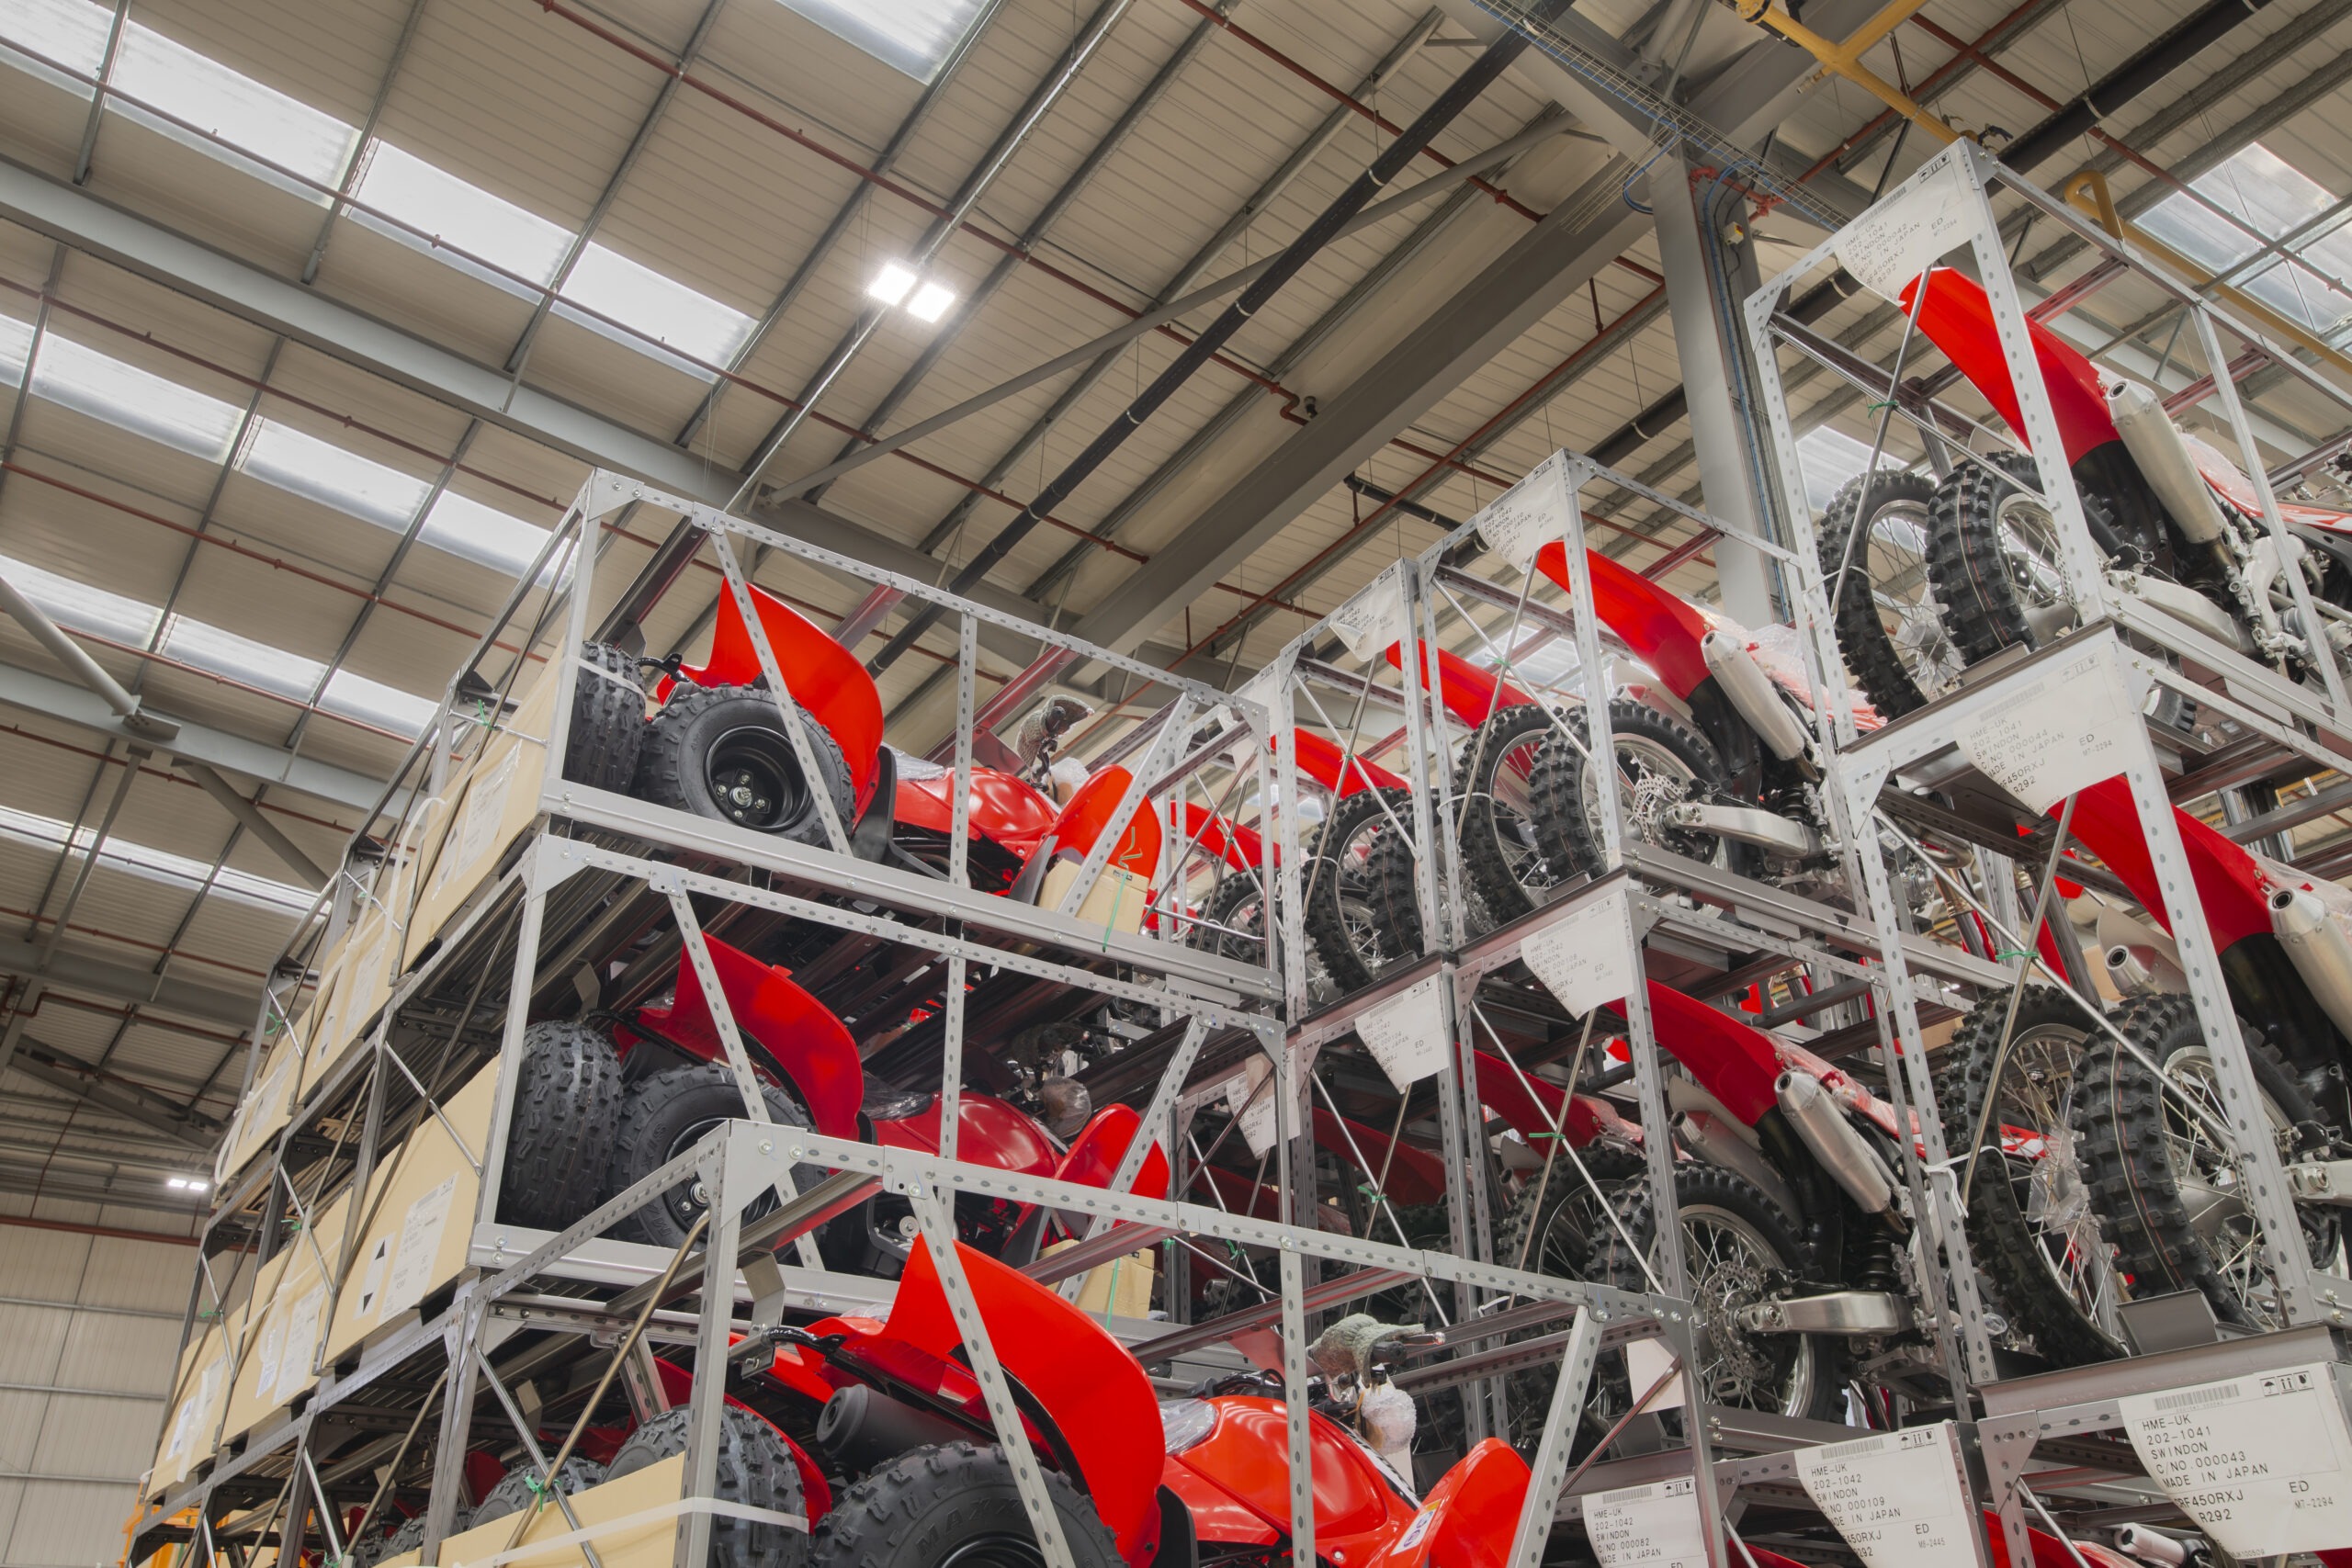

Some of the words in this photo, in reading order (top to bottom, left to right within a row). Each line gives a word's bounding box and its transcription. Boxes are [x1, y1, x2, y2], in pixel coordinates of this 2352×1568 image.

[1931, 217, 1943, 230] ED
[1880, 247, 1889, 256] IN
[1894, 222, 1921, 245] JAPAN
[1849, 233, 1885, 262] SWINDON
[1970, 718, 2007, 740] HME-UK
[1973, 720, 2022, 750] 202-1041
[1976, 733, 2019, 761] SWINDON
[2014, 753, 2025, 762] IN
[2032, 732, 2065, 753] JAPAN
[2079, 734, 2095, 746] ED
[2014, 775, 2036, 795] R292
[1594, 964, 1604, 973] ED
[1415, 1040, 1424, 1048] ED
[2143, 1414, 2191, 1432] HME-UK
[2147, 1426, 2211, 1446] 202-1041
[2151, 1442, 2209, 1460] SWINDON
[1811, 1463, 1847, 1477] HME-UK
[2163, 1474, 2191, 1488] MADE
[2201, 1472, 2216, 1483] IN
[2227, 1463, 2268, 1479] JAPAN
[1814, 1473, 1862, 1490] 202-1042
[2289, 1480, 2309, 1493] ED
[1816, 1487, 1858, 1503] SWINDON
[1594, 1507, 1623, 1519] HME-UK
[1852, 1513, 1862, 1523] IN
[1870, 1507, 1901, 1521] JAPAN
[2199, 1508, 2232, 1523] R292
[1595, 1517, 1634, 1530] 202-1042
[1916, 1523, 1929, 1534] ED
[1597, 1529, 1630, 1542] SWINDON
[1600, 1554, 1616, 1564] MADE
[1623, 1552, 1632, 1561] IN
[1637, 1548, 1661, 1559] JAPAN
[1853, 1547, 1873, 1558] 292
